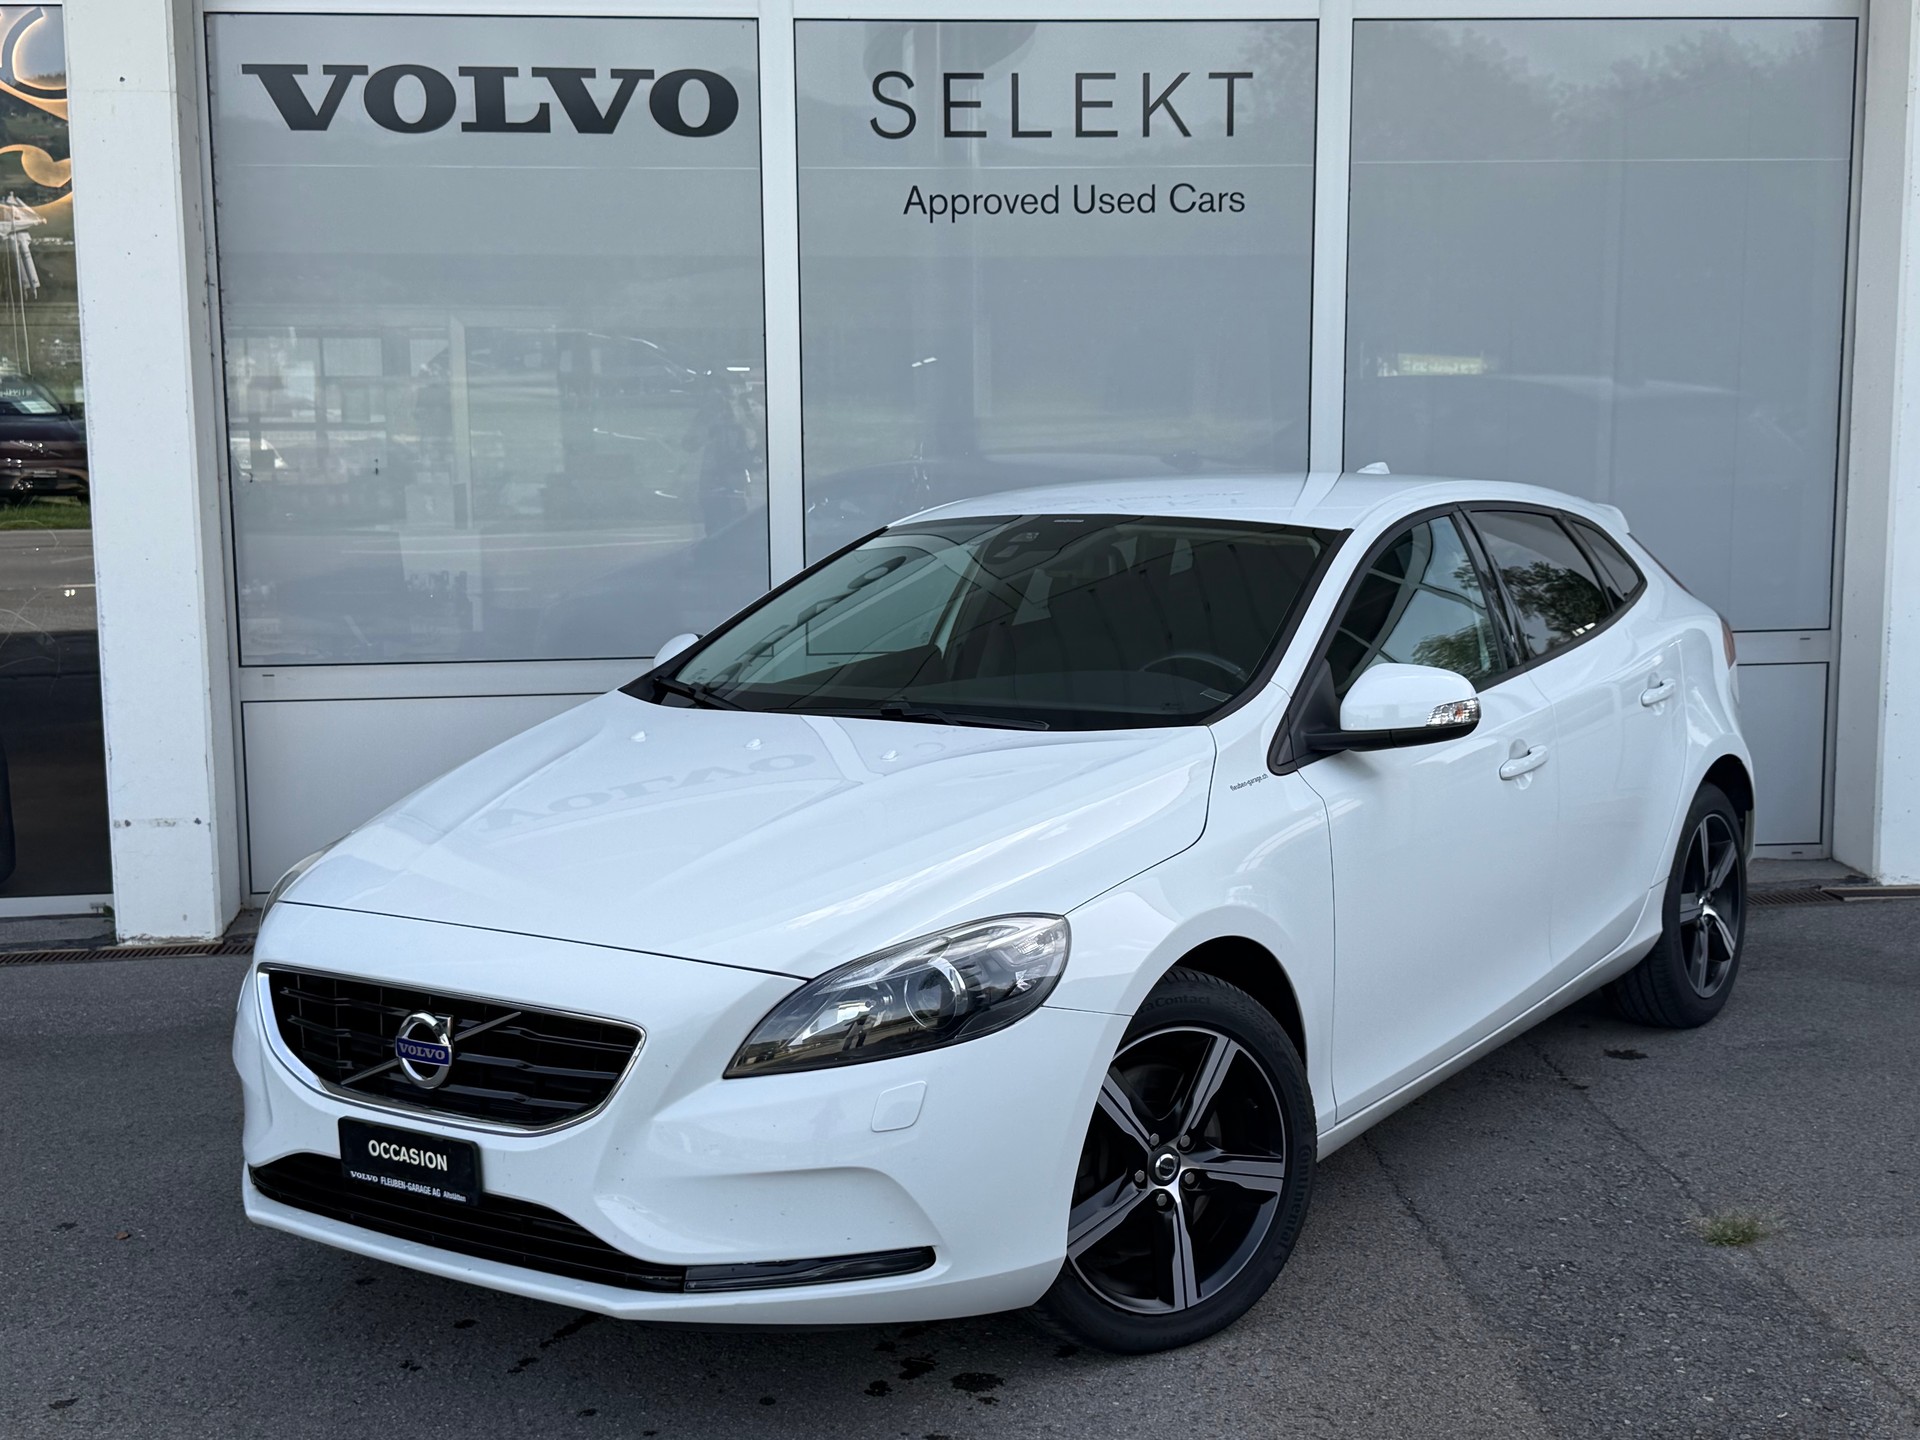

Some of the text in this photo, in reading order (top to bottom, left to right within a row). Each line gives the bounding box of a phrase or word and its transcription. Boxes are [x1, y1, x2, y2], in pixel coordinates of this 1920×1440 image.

[241, 64, 739, 137] VOLVO
[870, 71, 1253, 139] SELEKT
[903, 183, 1246, 223] Approved Used Cars
[398, 1042, 446, 1060] VOLVO
[368, 1139, 448, 1171] OCCASION
[350, 1170, 378, 1182] VOLVO
[380, 1176, 431, 1195] FLEUBEN-GARAGE
[432, 1188, 441, 1197] AG
